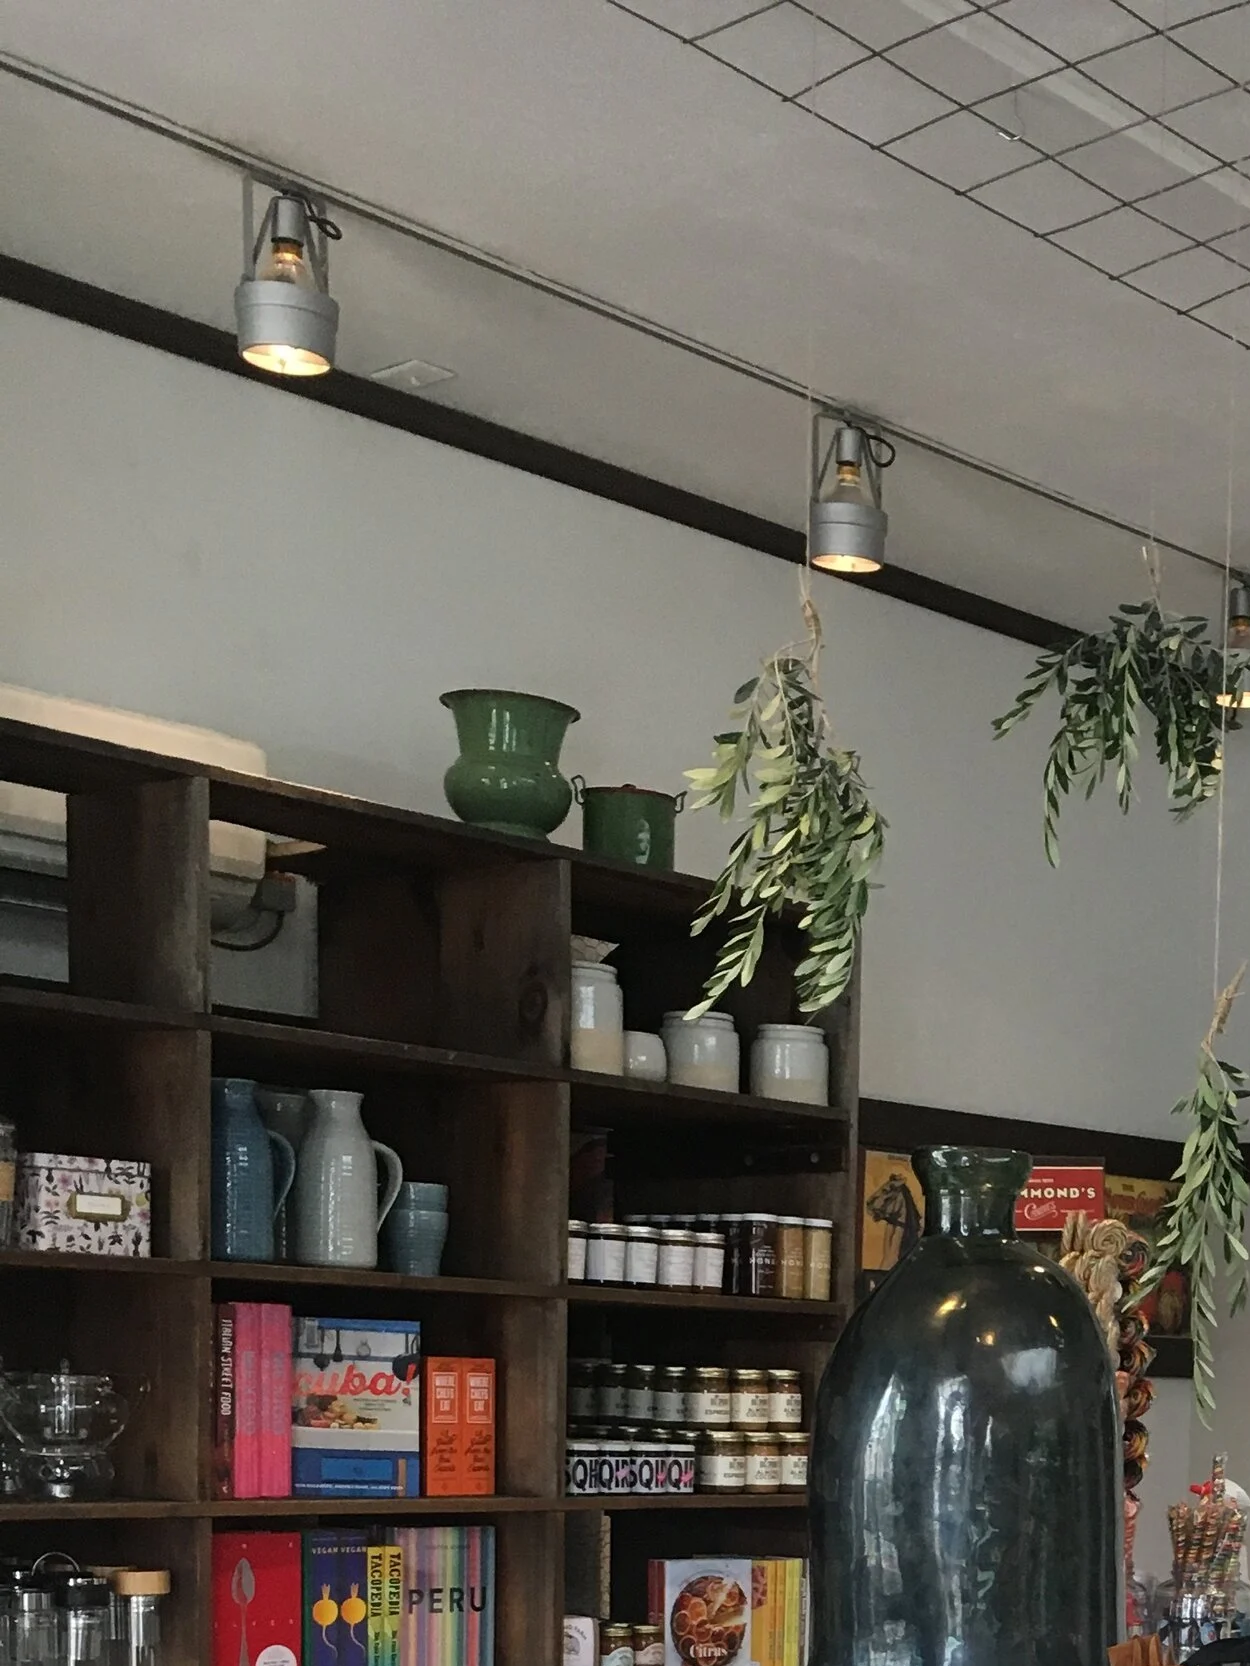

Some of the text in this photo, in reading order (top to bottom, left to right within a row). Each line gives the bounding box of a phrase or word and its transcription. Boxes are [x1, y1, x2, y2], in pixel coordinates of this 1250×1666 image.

[221, 1356, 233, 1388] STREET
[220, 1391, 232, 1416] FOOD
[370, 1554, 382, 1617] TACOPEDIA
[389, 1553, 401, 1615] TACOPEDIA
[408, 1587, 487, 1614] PERU
[689, 1644, 729, 1659] Citrus
